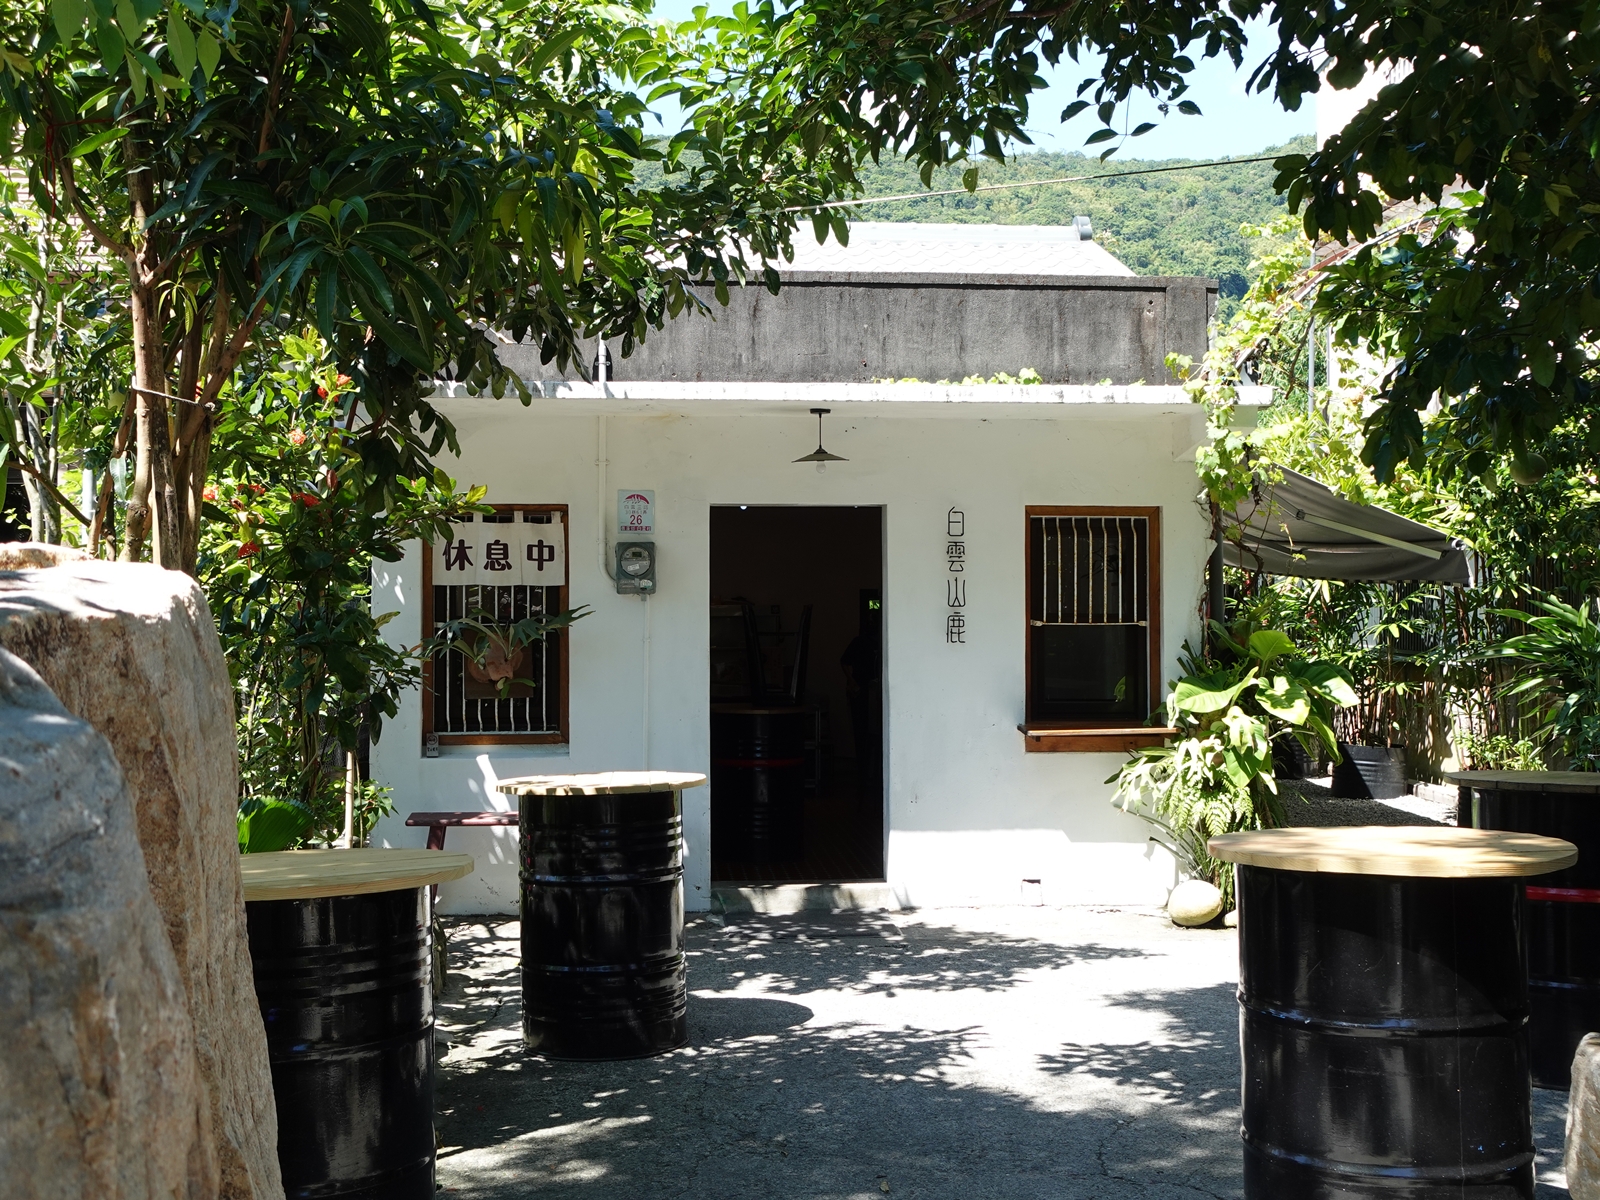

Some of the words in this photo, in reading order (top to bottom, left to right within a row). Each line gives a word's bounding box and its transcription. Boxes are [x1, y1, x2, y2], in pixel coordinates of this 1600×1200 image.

[629, 514, 643, 525] 26
[442, 538, 555, 572] 休息中
[946, 506, 966, 644] 白雲山鹿
